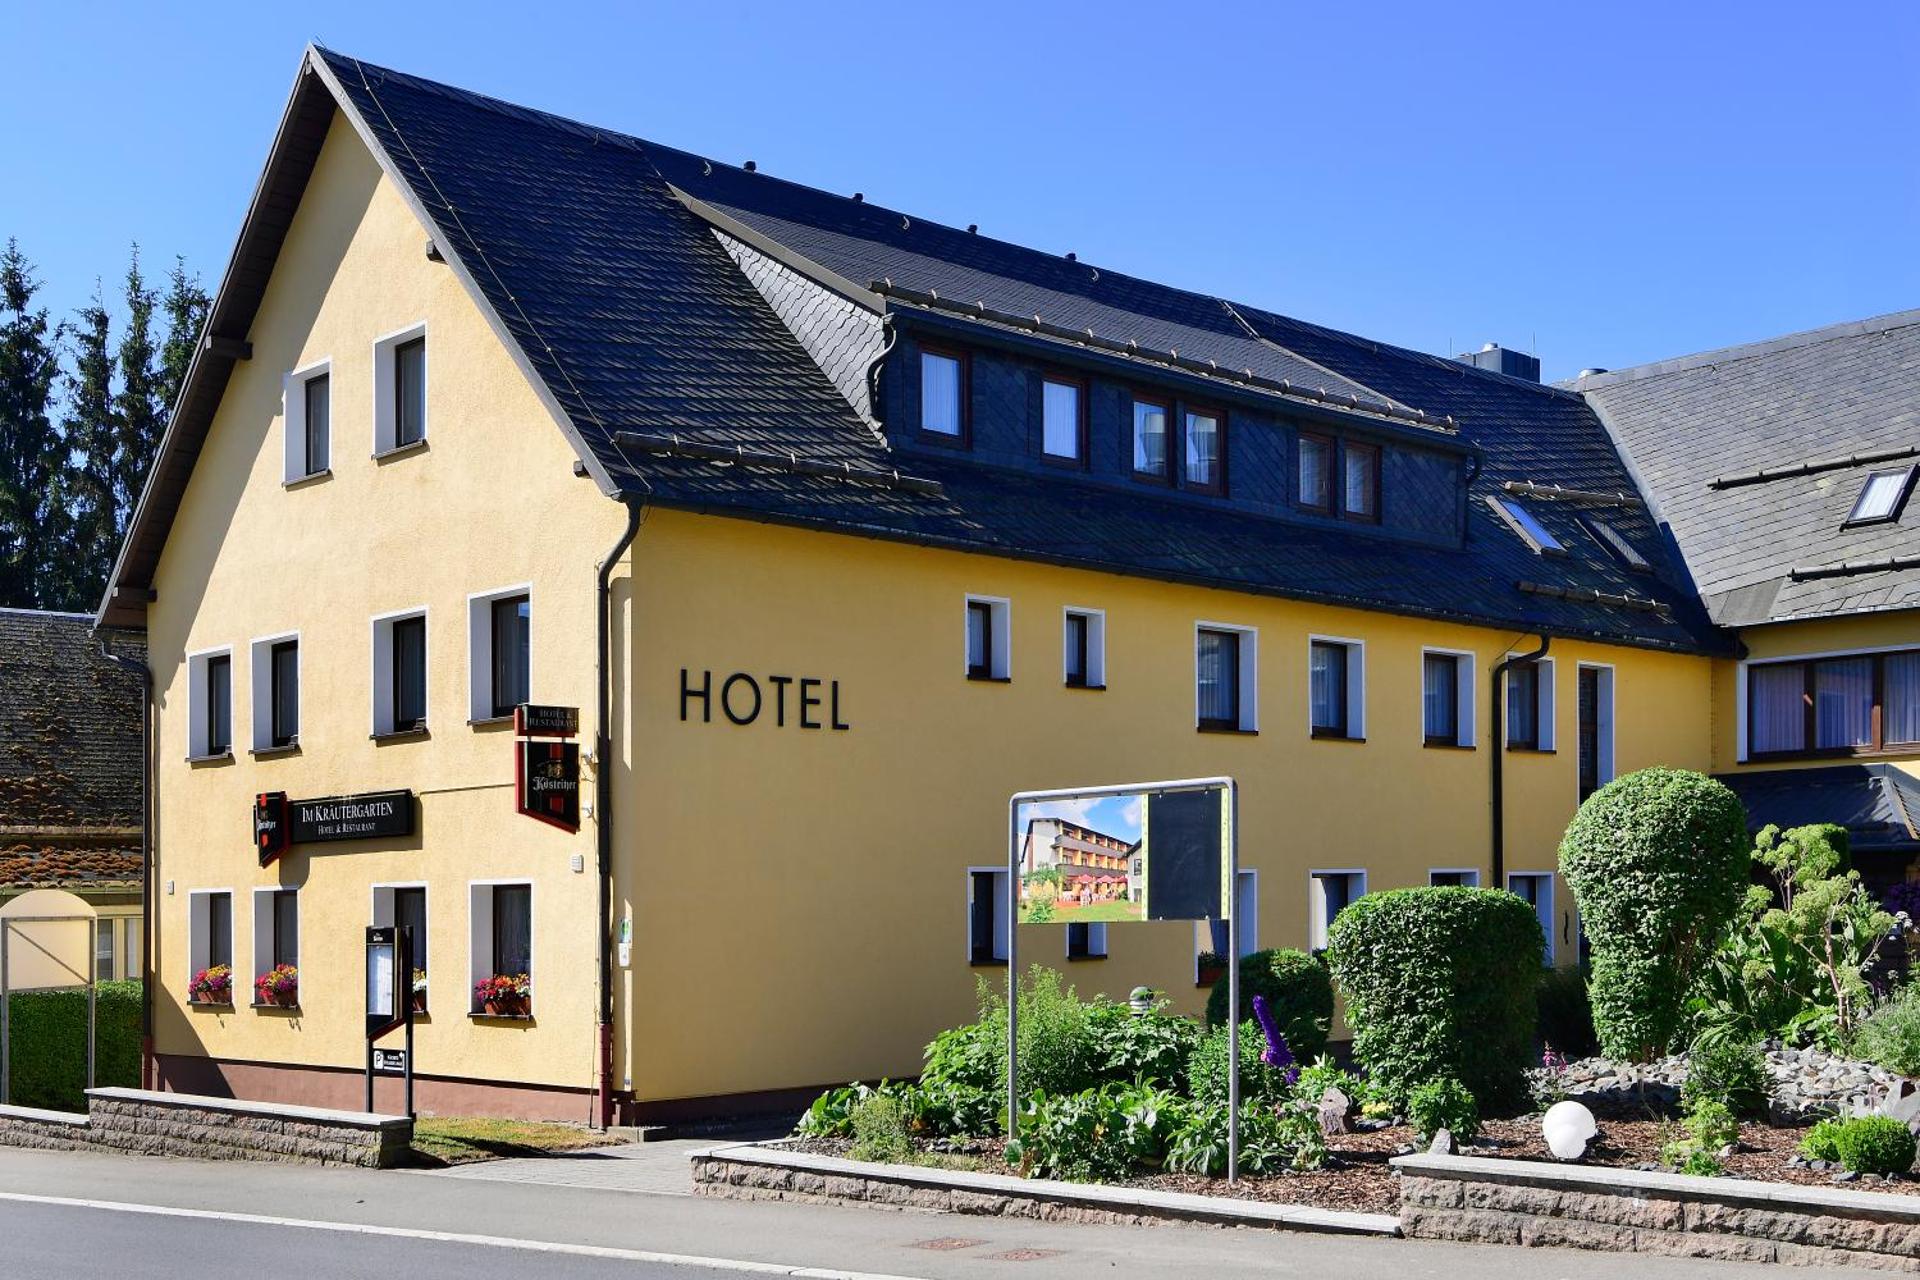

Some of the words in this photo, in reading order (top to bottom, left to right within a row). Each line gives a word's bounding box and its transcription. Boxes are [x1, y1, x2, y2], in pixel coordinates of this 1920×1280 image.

[680, 669, 850, 731] HOTEL
[302, 807, 313, 823] IM
[315, 802, 393, 821] KRÄUTERGARTEN
[318, 824, 335, 835] HOTEL
[336, 824, 341, 833] &
[342, 822, 376, 833] RESTAURANT
